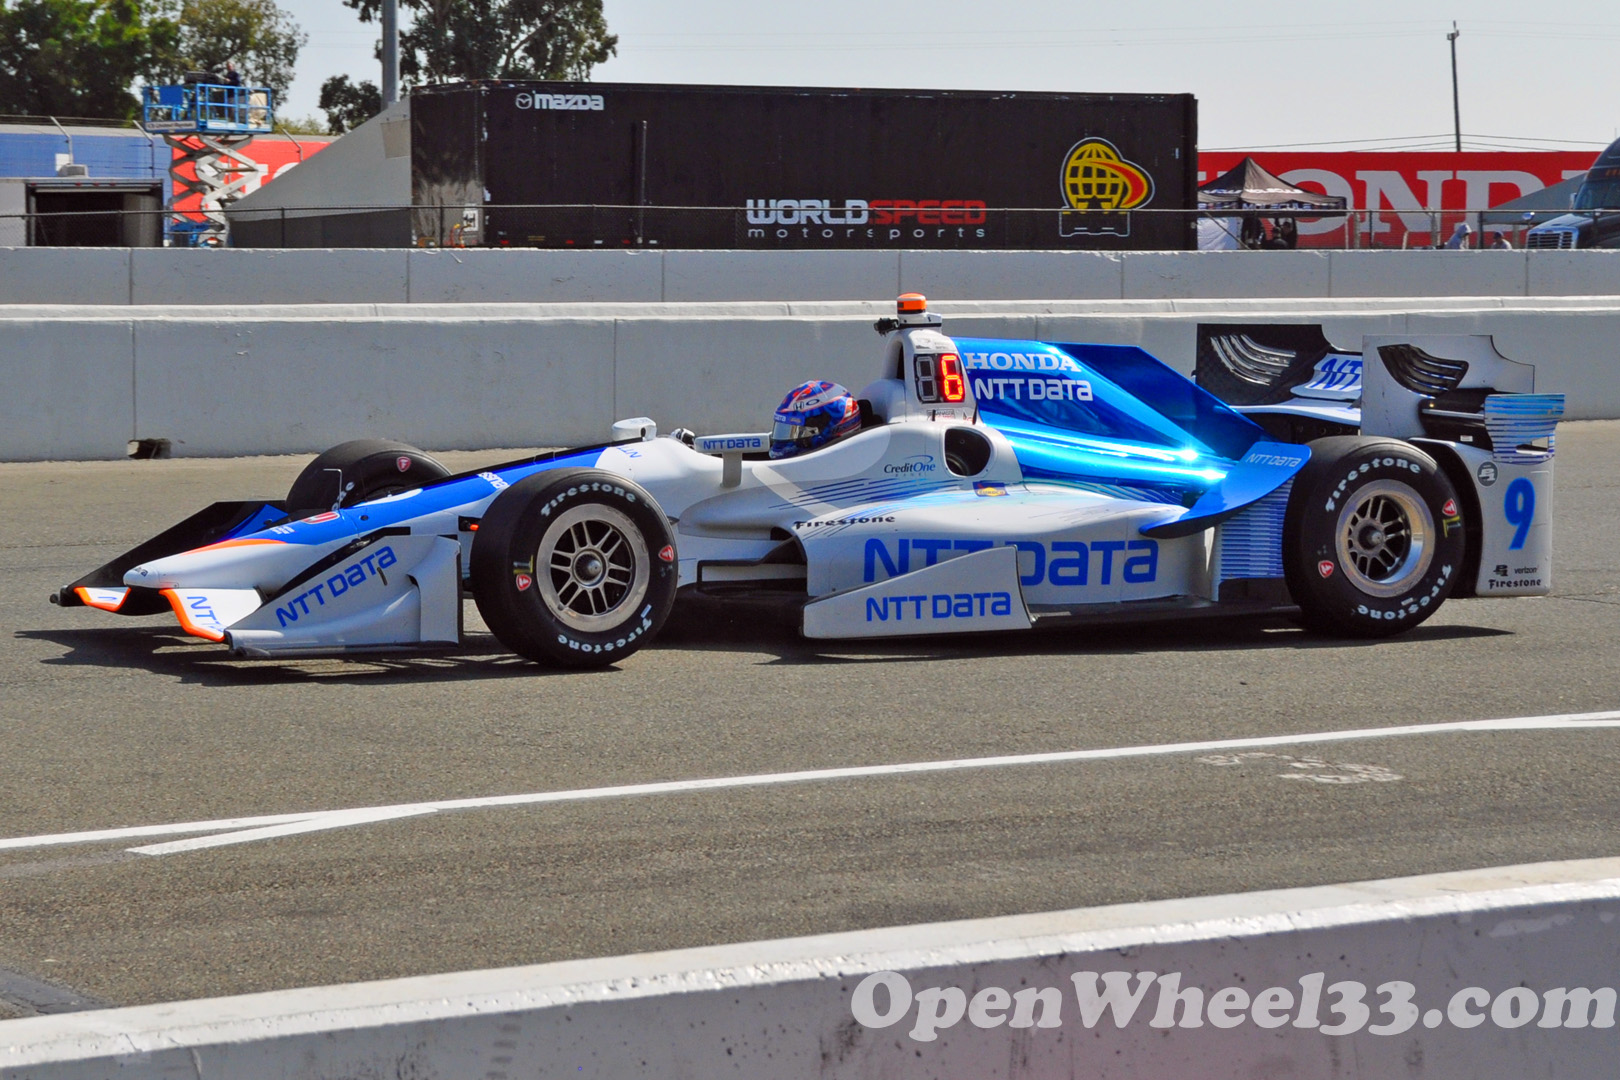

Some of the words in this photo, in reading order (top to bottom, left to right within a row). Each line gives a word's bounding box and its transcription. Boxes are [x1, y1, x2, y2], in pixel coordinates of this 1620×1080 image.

[747, 227, 986, 240] motorsports
[964, 352, 1081, 372] HONDA
[974, 378, 1025, 400] NTT
[703, 439, 725, 450] NTT
[1245, 453, 1272, 464] NTT
[1325, 457, 1421, 512] Firestone
[540, 482, 636, 517] Firestone
[793, 516, 895, 530] Firestone
[1504, 477, 1535, 550] 9
[1357, 564, 1452, 620] Firestone
[1488, 579, 1542, 589] Firestone
[275, 583, 325, 627] NTT
[866, 596, 927, 622] NTT
[557, 618, 652, 654] Firestone
